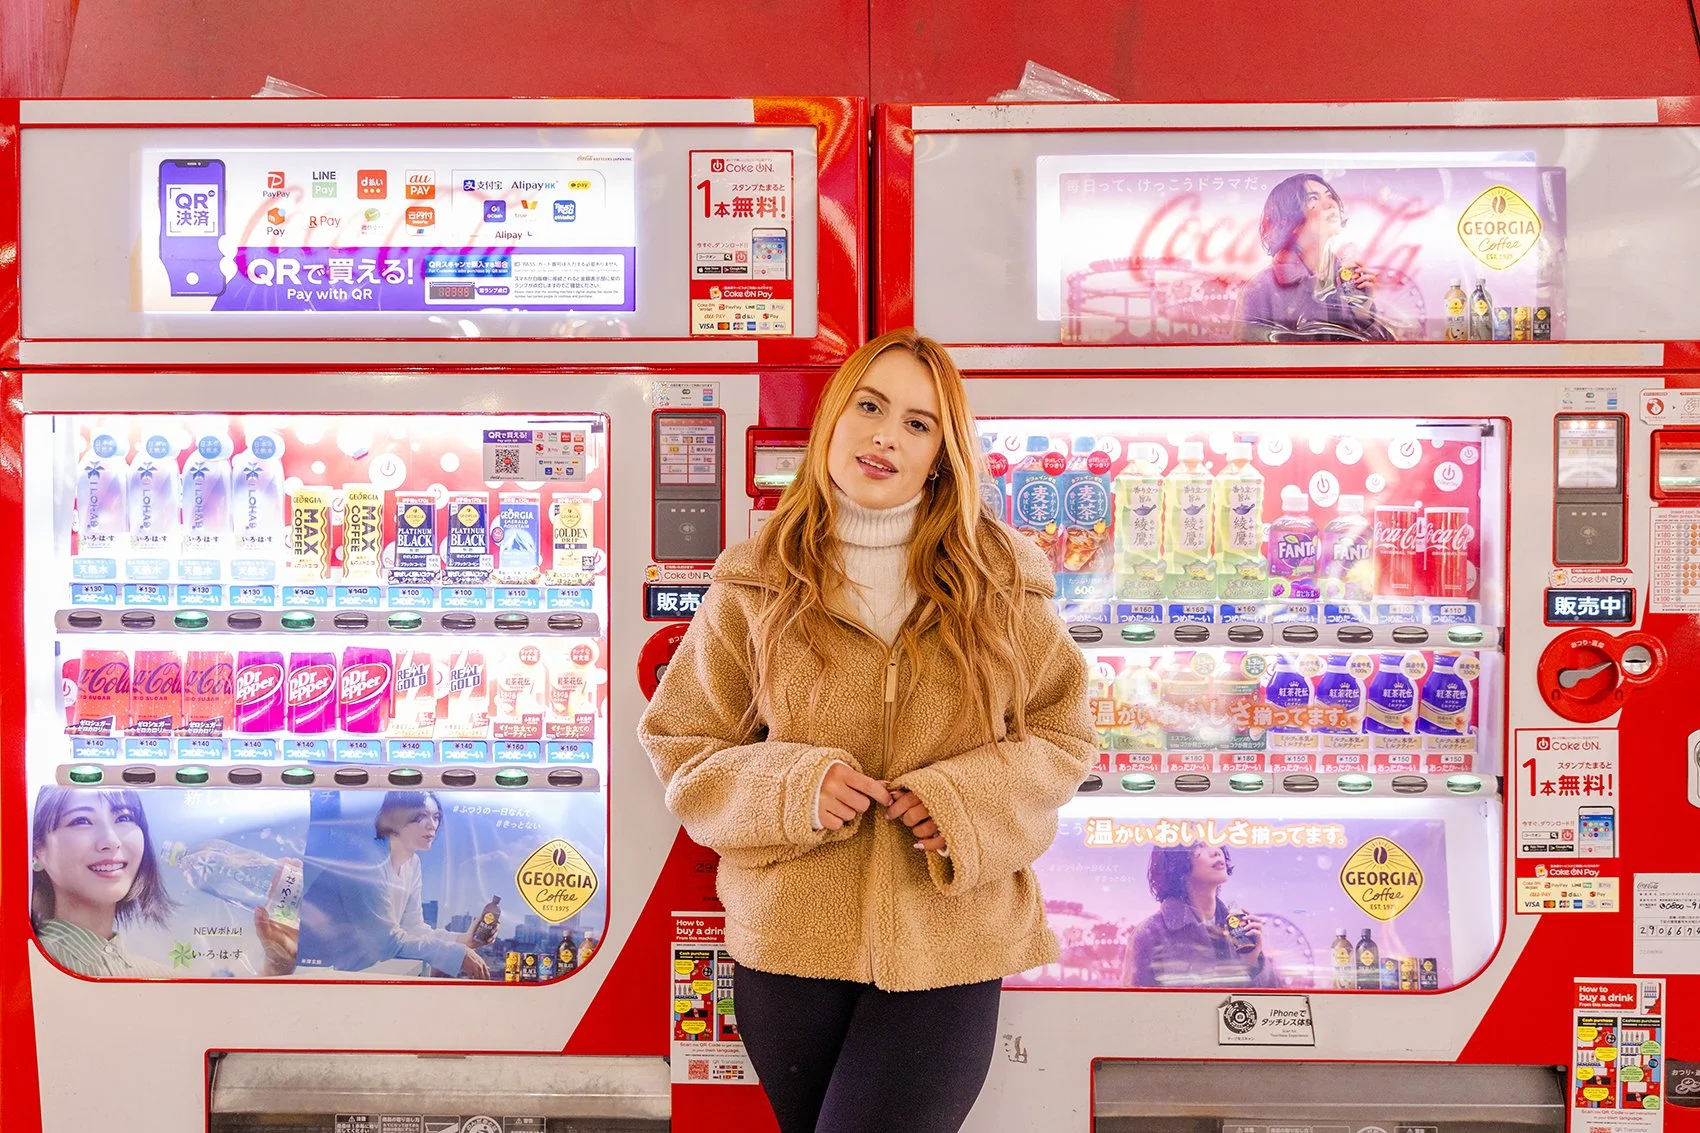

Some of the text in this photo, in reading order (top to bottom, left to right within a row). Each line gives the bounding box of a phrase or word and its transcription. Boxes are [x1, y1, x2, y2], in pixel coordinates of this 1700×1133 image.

[726, 164, 754, 172] Coke
[312, 172, 336, 180] LINE
[361, 176, 384, 187] d払い
[408, 174, 432, 184] au
[315, 185, 334, 196] Pay
[410, 186, 430, 195] PAY
[476, 181, 502, 190] 支付宝
[732, 184, 786, 192] スタンプたまると
[1066, 178, 1268, 194] 毎日って、けっこうドラマだ。
[262, 190, 290, 199] PayPay
[697, 180, 786, 218] 1本無料!
[175, 193, 208, 210] QR
[176, 210, 210, 226] 決済
[320, 216, 341, 228] Pay
[266, 226, 286, 237] Pay
[1462, 221, 1536, 235] GEORGIA
[495, 231, 522, 240] Alipay
[1478, 236, 1522, 253] Coffee
[248, 258, 414, 285] QRで買える!
[287, 288, 372, 301] Pay with QR
[724, 290, 744, 298] Coke
[758, 290, 772, 300] Pay
[1030, 485, 1050, 522] 麦茶
[1077, 485, 1097, 522] 麦茶
[1138, 495, 1152, 503] 旨み
[1188, 495, 1201, 503] 旨み
[1238, 494, 1250, 502] 旨み
[500, 510, 534, 520] GEORGIA
[294, 508, 302, 555] COFFEE
[304, 508, 318, 555] MAX
[351, 506, 360, 552] COFFEE
[362, 506, 376, 552] MAX
[554, 528, 588, 540] GOLDEN
[1134, 518, 1148, 547] 綾鷹
[1184, 518, 1198, 547] 綾鷹
[1233, 517, 1248, 548] 綾鷹
[398, 534, 432, 547] BLACK
[450, 534, 486, 546] BLACK
[1278, 541, 1316, 559] FANTA
[664, 571, 686, 580] Coke
[688, 570, 702, 580] ON
[1570, 574, 1628, 584] Coke ON Pay
[656, 592, 706, 612] 販売
[1555, 596, 1621, 616] 販売中
[244, 670, 262, 686] Dr
[298, 670, 318, 686] Dr
[350, 670, 369, 686] Dr
[397, 663, 426, 680] REAL
[451, 664, 480, 680] REAL
[236, 676, 275, 700] Pepper
[289, 676, 328, 701] Pepper
[342, 676, 381, 700] Pepper
[397, 674, 426, 691] GOLD
[450, 675, 480, 692] GOLD
[1279, 687, 1309, 696] 紅茶花伝
[1329, 688, 1360, 698] 紅茶花伝
[1382, 688, 1413, 698] 紅茶花伝
[1436, 690, 1467, 699] 紅茶花伝
[1552, 740, 1599, 751] Coke ON
[1558, 762, 1612, 770] スタンプたまると
[1522, 758, 1613, 796] 1本無料!
[452, 806, 534, 818] #ふつうの一日なんて
[1087, 820, 1345, 846] 温かいおいしさ揃ってます。
[1345, 872, 1416, 886] GEORGIA
[1584, 868, 1600, 877] Pay
[522, 872, 593, 889] GEORGIA
[536, 888, 578, 903] Coffee
[1362, 887, 1404, 902] Coffee
[194, 926, 242, 937] NEWボトル!
[676, 926, 694, 936] buy
[190, 949, 242, 961] い・ろ・は・す
[1579, 994, 1598, 1004] buy
[1608, 994, 1634, 1002] drink
[1270, 1008, 1306, 1017] iPhoneで
